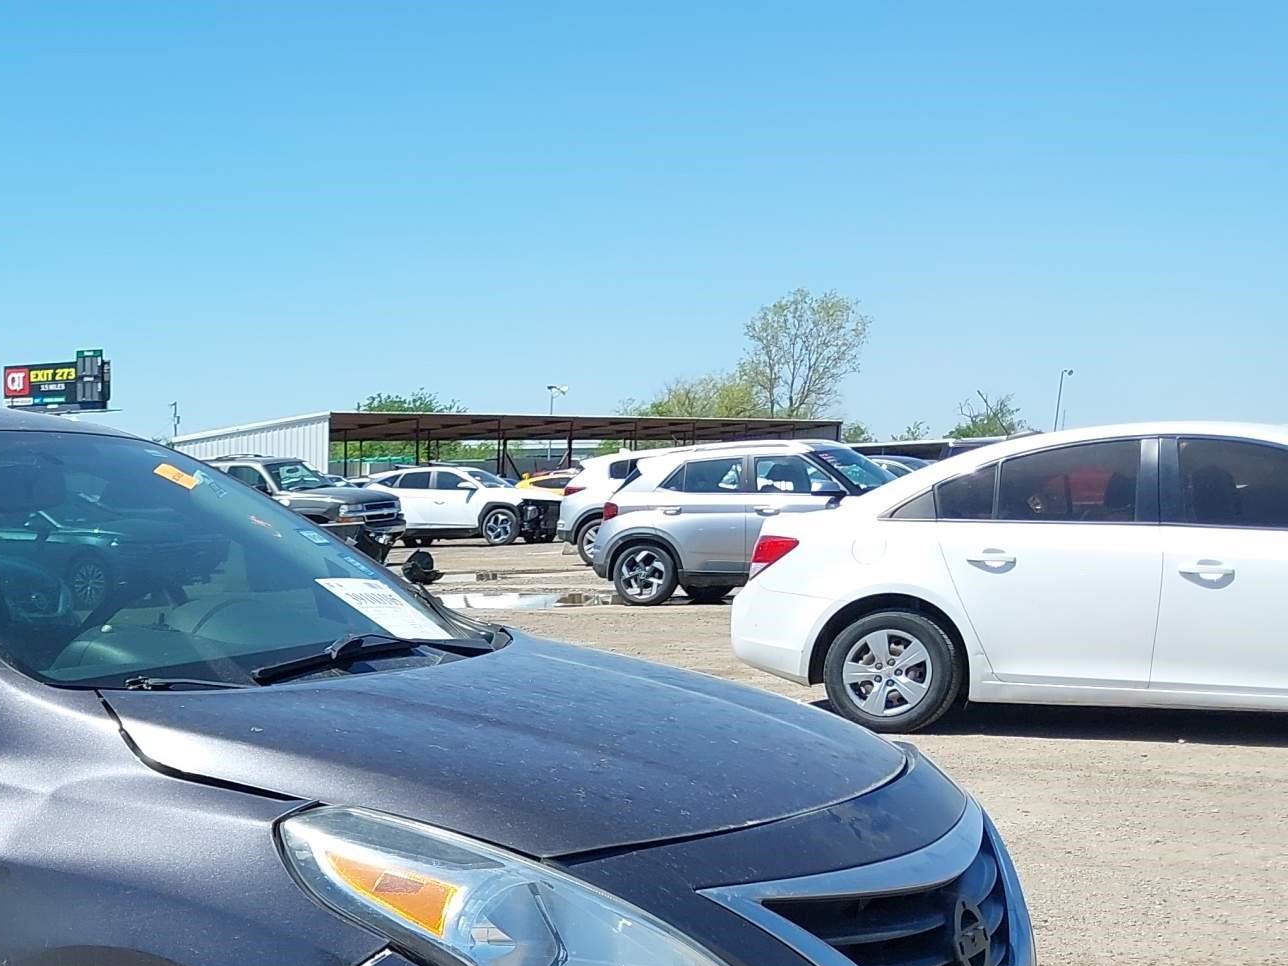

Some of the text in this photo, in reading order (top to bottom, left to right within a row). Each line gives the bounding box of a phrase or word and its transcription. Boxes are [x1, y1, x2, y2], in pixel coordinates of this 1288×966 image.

[7, 372, 25, 391] QT
[30, 370, 53, 382] EXIT
[55, 368, 76, 380] 273
